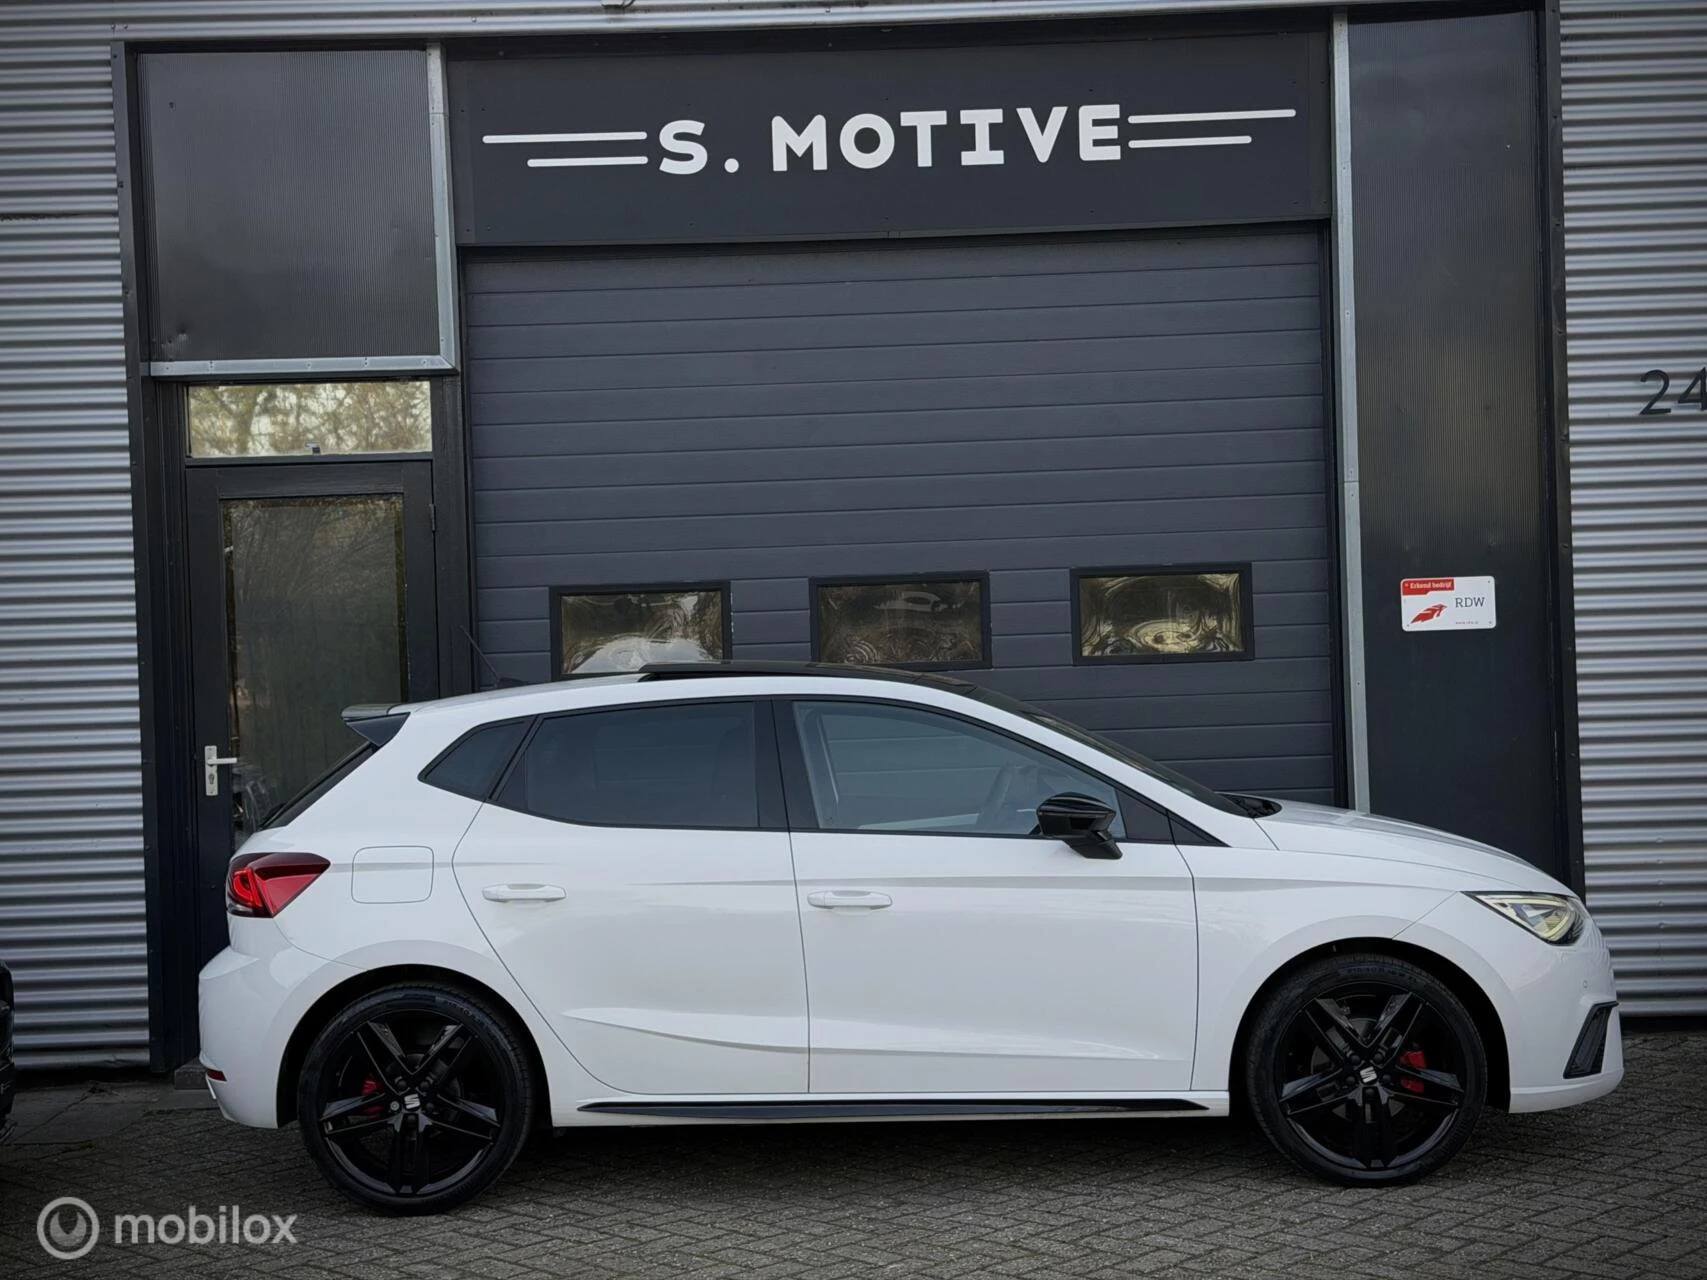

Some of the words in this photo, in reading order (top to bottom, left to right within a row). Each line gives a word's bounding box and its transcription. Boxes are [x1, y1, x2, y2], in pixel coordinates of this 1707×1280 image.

[658, 119, 740, 175] S.
[771, 103, 1122, 173] MOTIVE
[1639, 366, 1707, 415] 24
[1455, 596, 1485, 608] RDW
